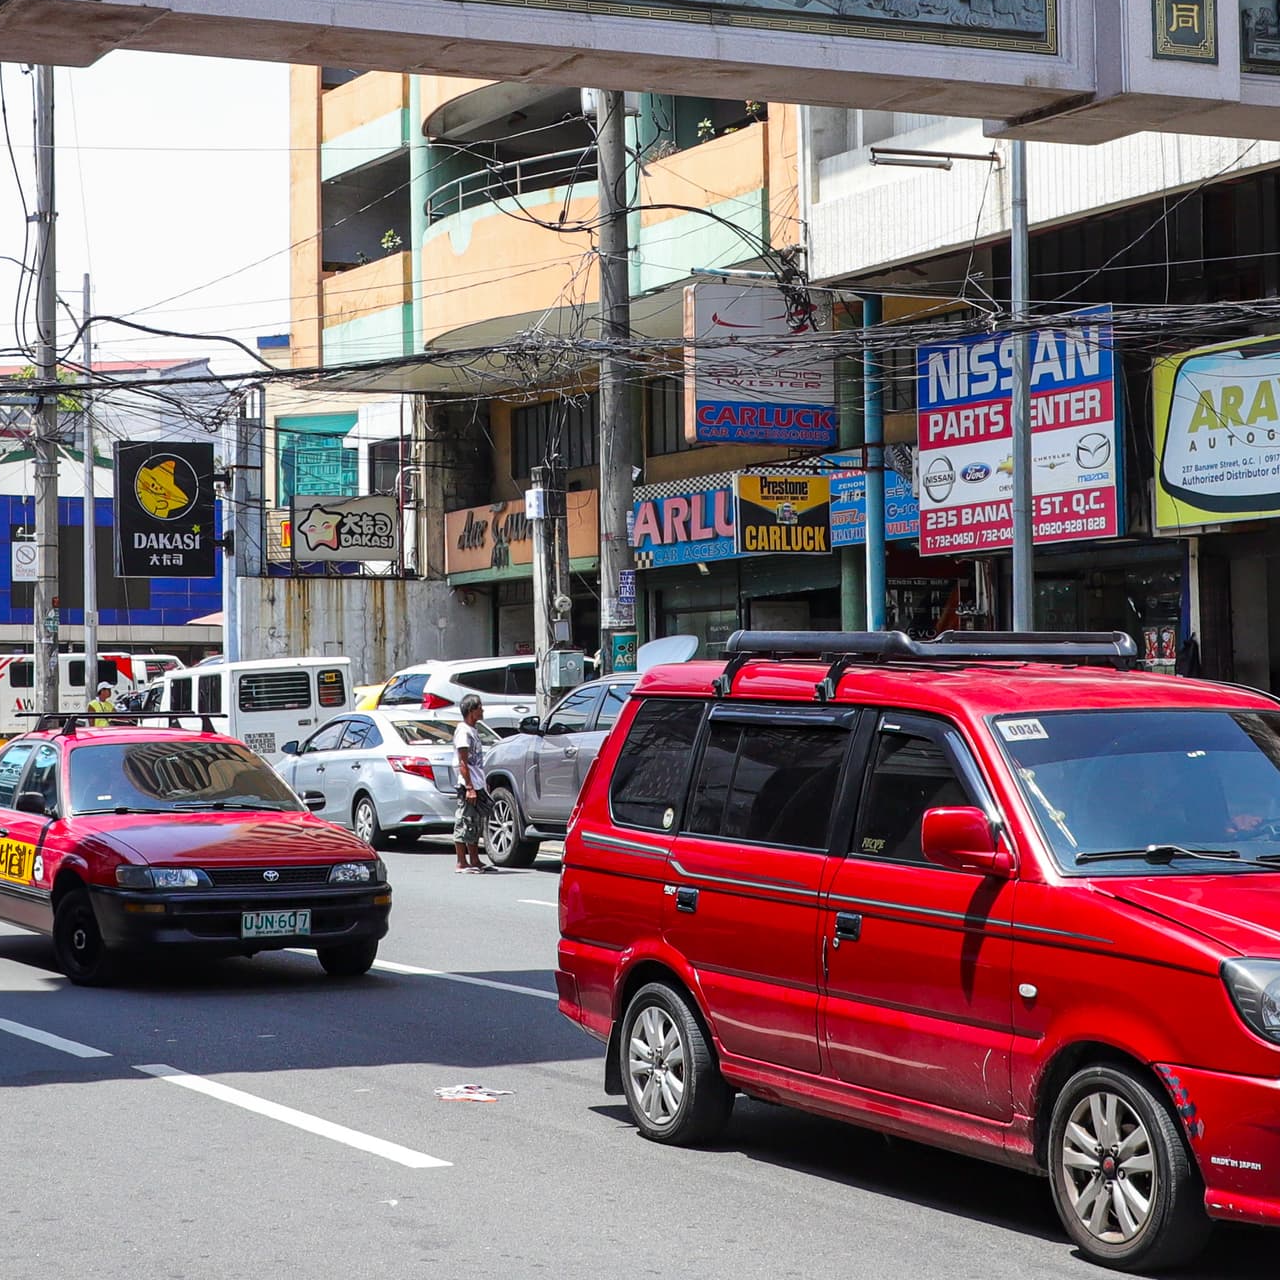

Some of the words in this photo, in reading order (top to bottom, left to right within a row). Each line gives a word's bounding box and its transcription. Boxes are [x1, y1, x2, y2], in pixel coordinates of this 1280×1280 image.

[715, 378, 822, 390] TWISTER
[697, 405, 833, 431] CARLUCK
[927, 403, 1005, 443] PARTS
[700, 427, 730, 437] CAR
[734, 427, 831, 441] ACCESSORIES
[760, 476, 809, 495] Prestone
[925, 472, 954, 485] NISSAN
[1181, 473, 1225, 487] Authorized
[1226, 468, 1270, 481] Distributor
[1271, 466, 1280, 476] of
[926, 509, 958, 530] 235
[1039, 495, 1069, 516] ST.
[1071, 490, 1106, 515] Q.C.
[133, 532, 201, 551] DAKASI
[339, 534, 394, 549] DAKASI
[744, 525, 827, 552] CARLUCK
[148, 553, 184, 567] 大卡司
[654, 549, 679, 564] CAR
